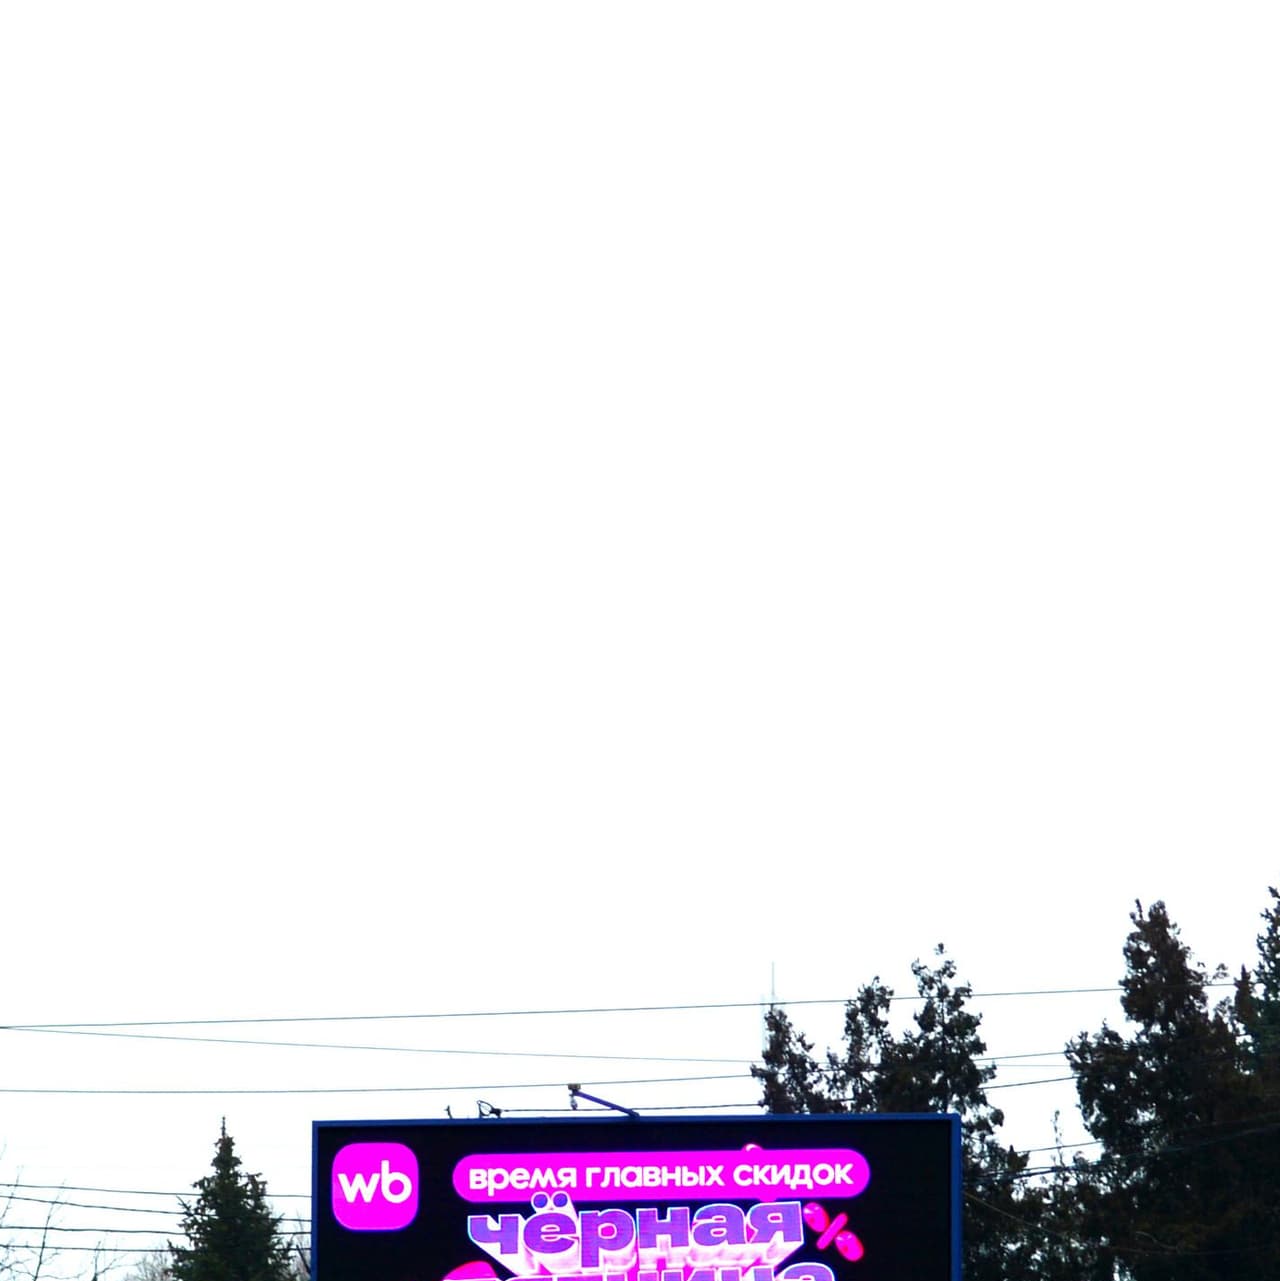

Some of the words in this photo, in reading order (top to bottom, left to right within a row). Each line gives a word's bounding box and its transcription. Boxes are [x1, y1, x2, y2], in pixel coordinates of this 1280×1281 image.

[337, 1160, 412, 1204] wb
[469, 1167, 577, 1197] время
[585, 1165, 725, 1189] главных
[733, 1163, 854, 1190] скидок
[467, 1191, 804, 1271] чёрная
